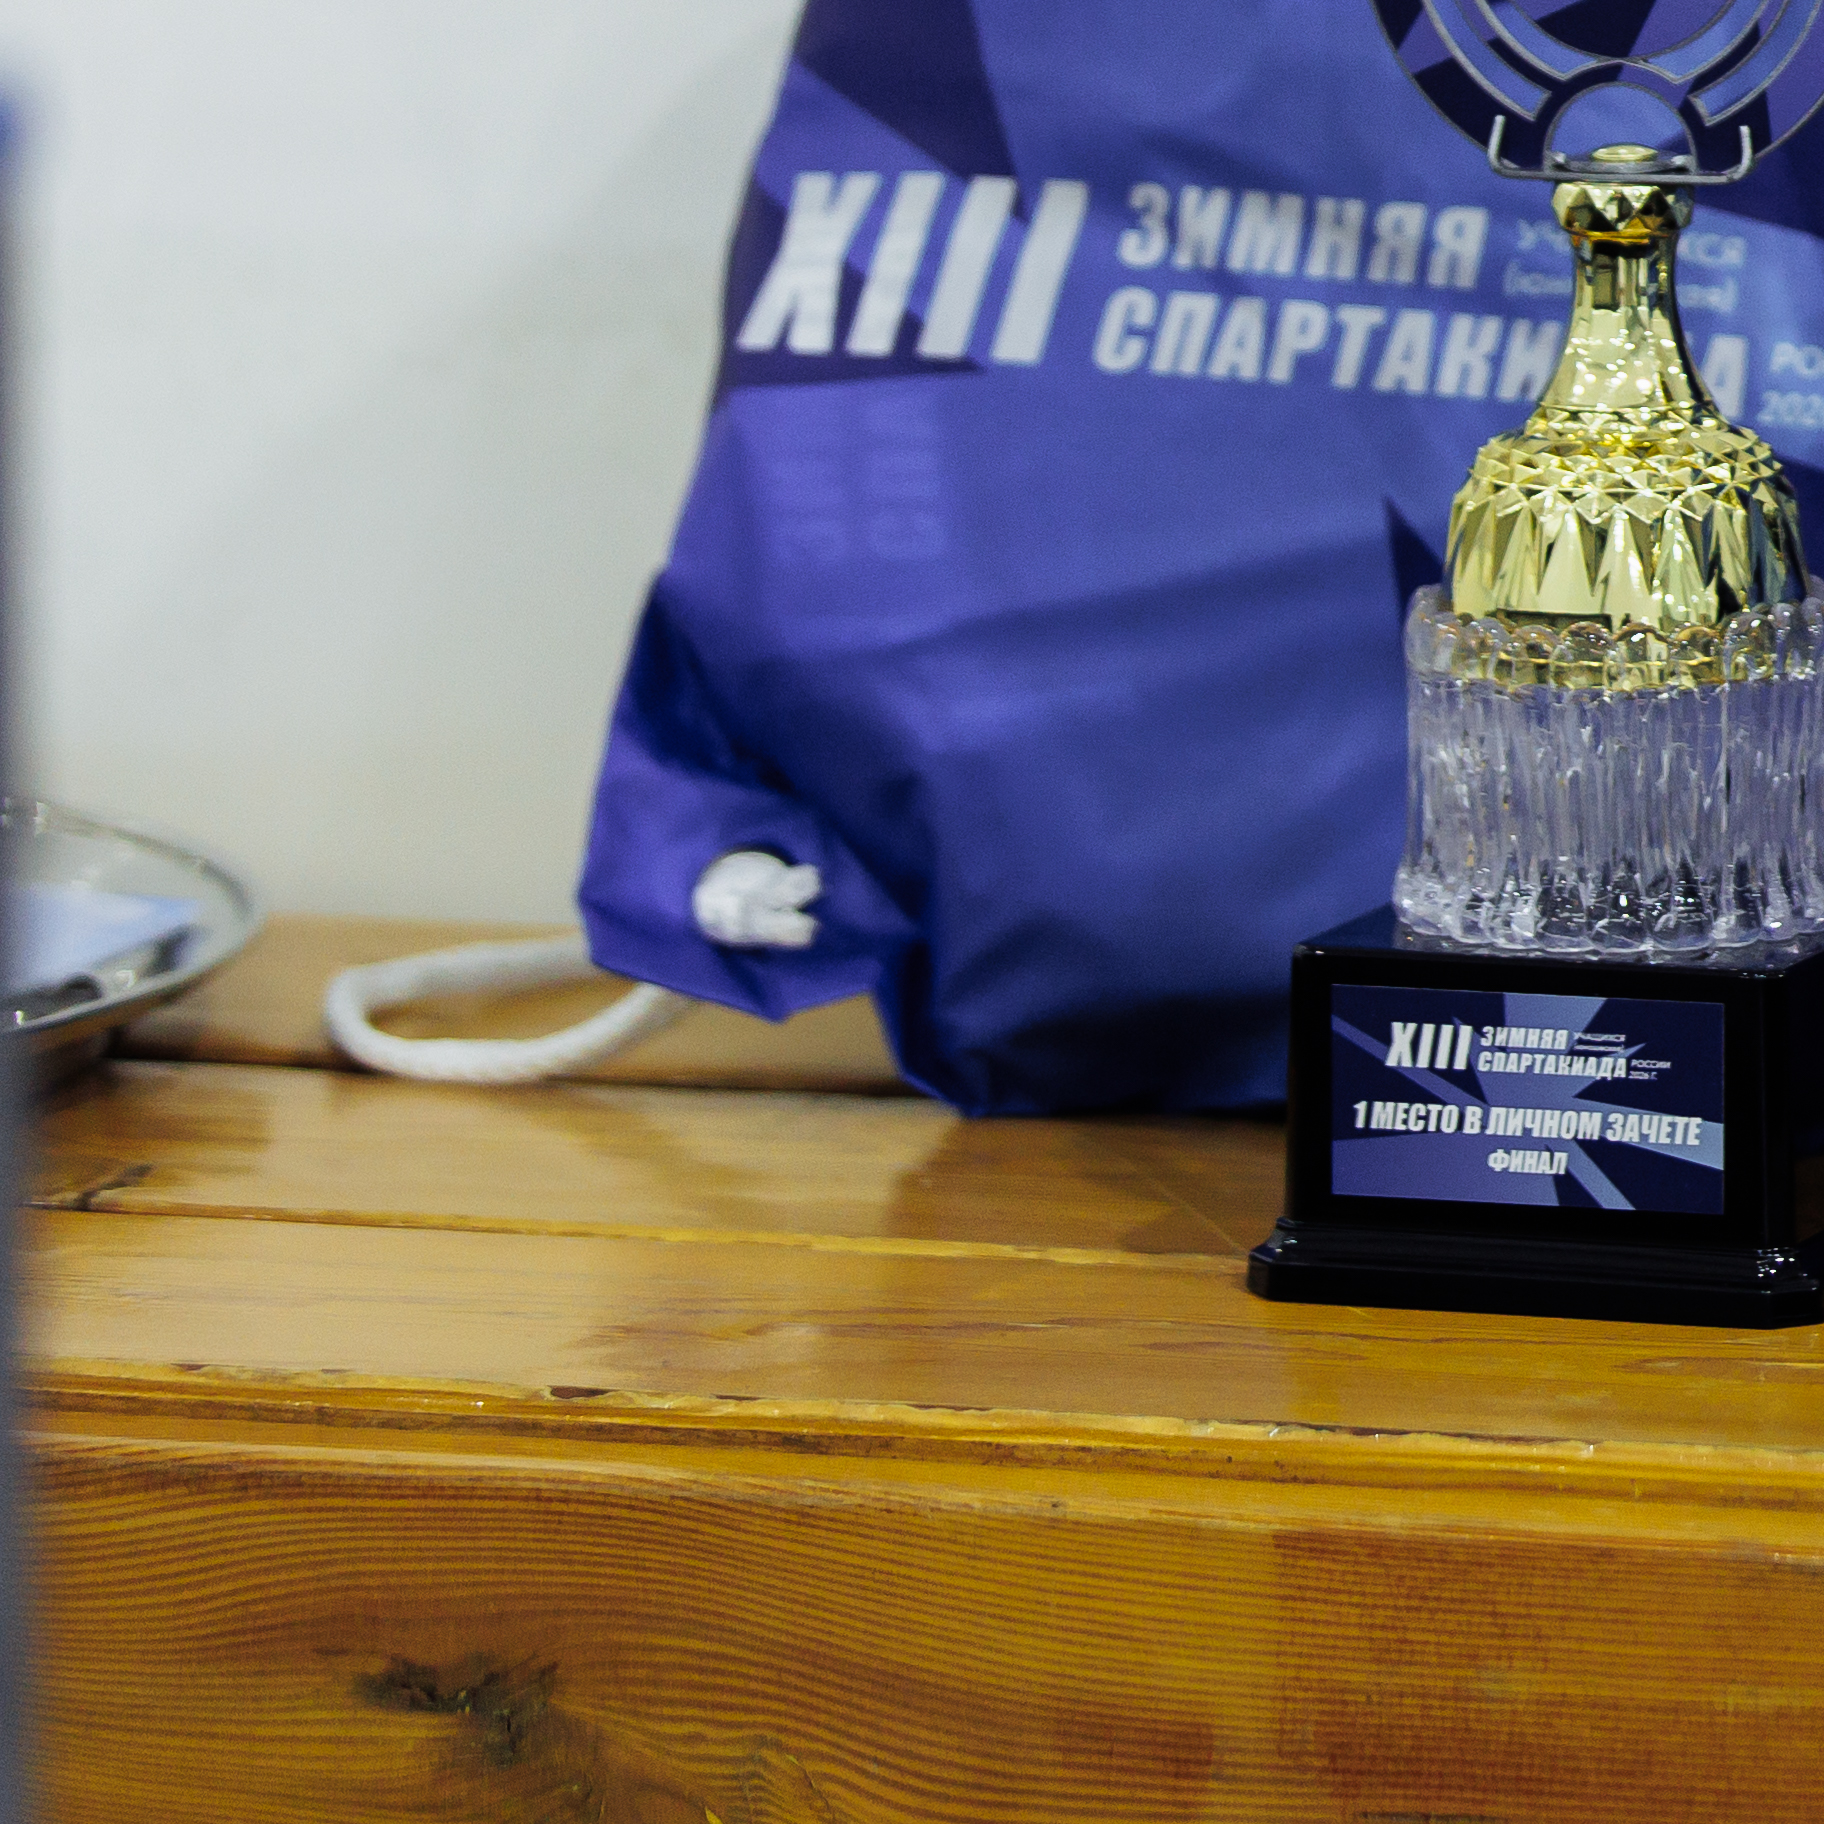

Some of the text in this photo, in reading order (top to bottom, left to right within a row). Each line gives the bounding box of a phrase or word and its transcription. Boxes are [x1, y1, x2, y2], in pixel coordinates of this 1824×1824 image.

[1116, 182, 1491, 290] ЗИМНЯЯ
[737, 171, 1090, 365] XIII
[1093, 286, 1750, 419] СПАРТАКИА
[1385, 1021, 1473, 1070] XIII
[1479, 1025, 1569, 1050] ЗИМНЯЯ
[1477, 1051, 1627, 1081] СПАРТАКИАДА
[1353, 1100, 1703, 1146] 1 МЕСТО В ЛИЧНОМ ЗАЧЕТЕ
[1487, 1149, 1569, 1176] ФИНАЛ
